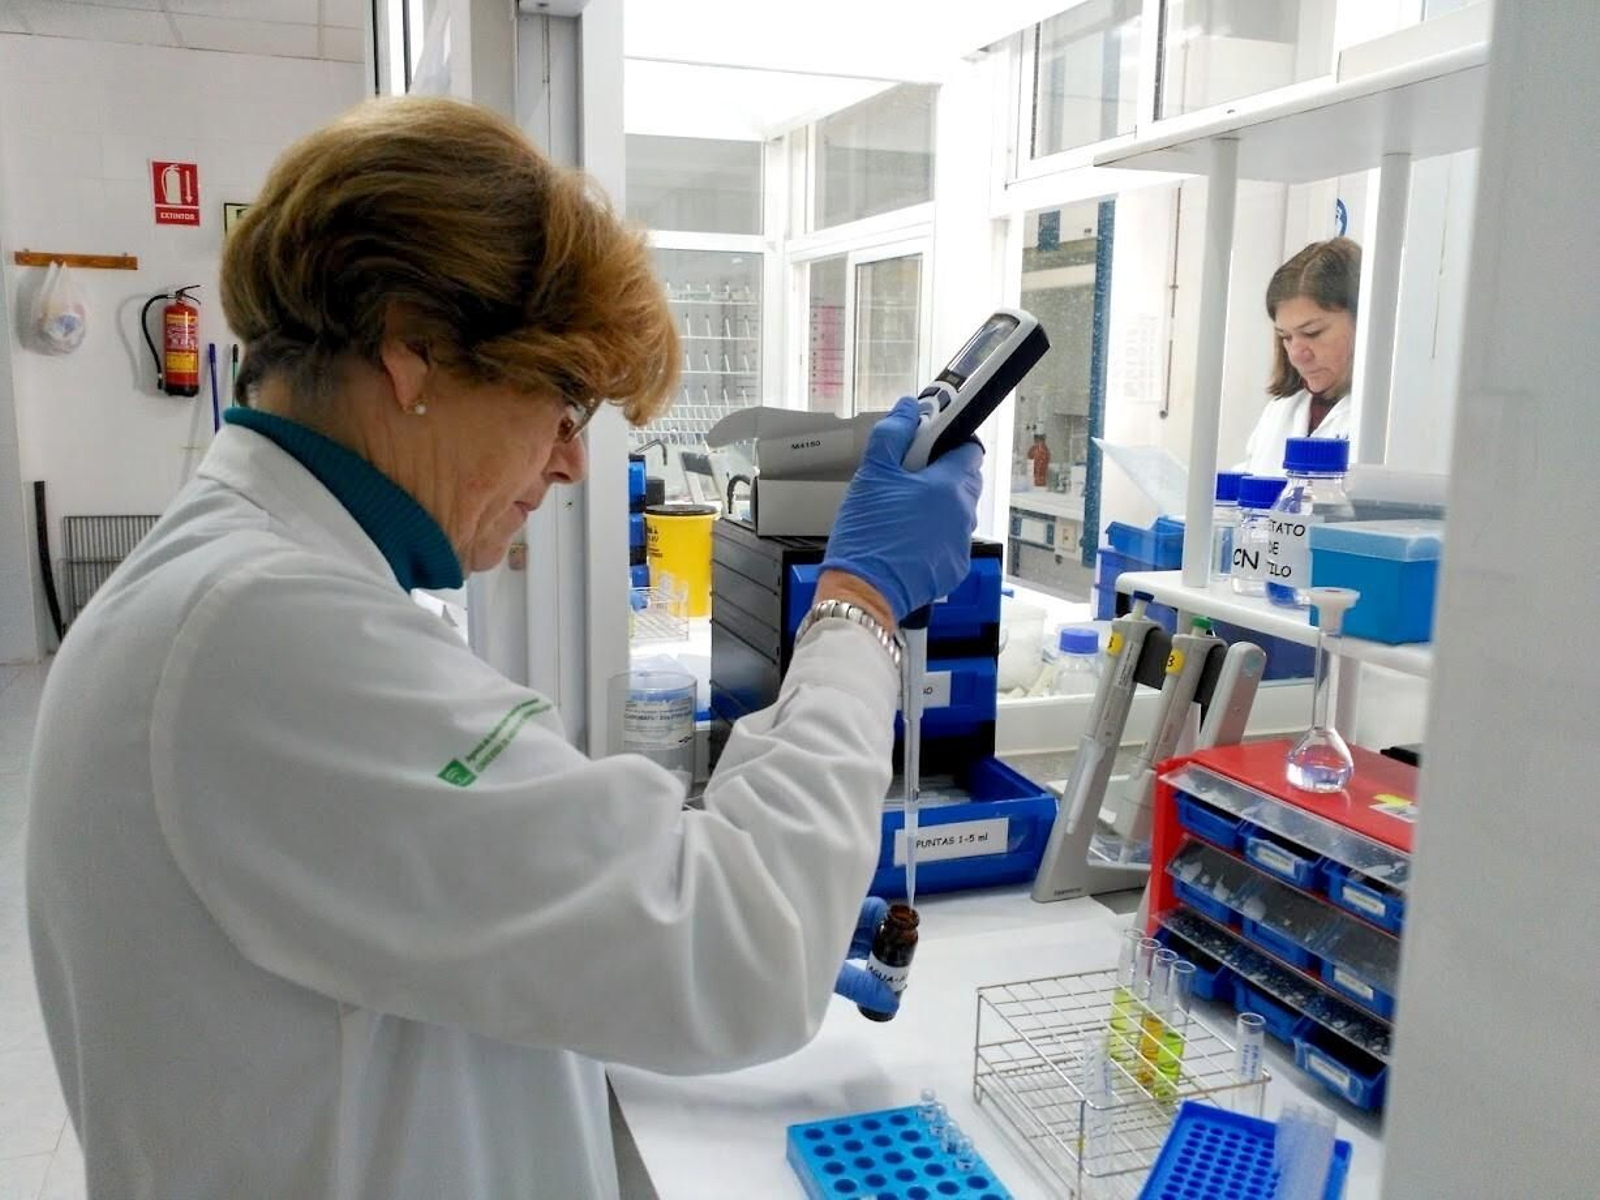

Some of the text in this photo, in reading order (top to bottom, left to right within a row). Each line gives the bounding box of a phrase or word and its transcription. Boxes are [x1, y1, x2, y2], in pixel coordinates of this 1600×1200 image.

[160, 212, 195, 220] EXTINTOR
[916, 836, 955, 849] PUNTAS
[958, 834, 975, 844] 1-5
